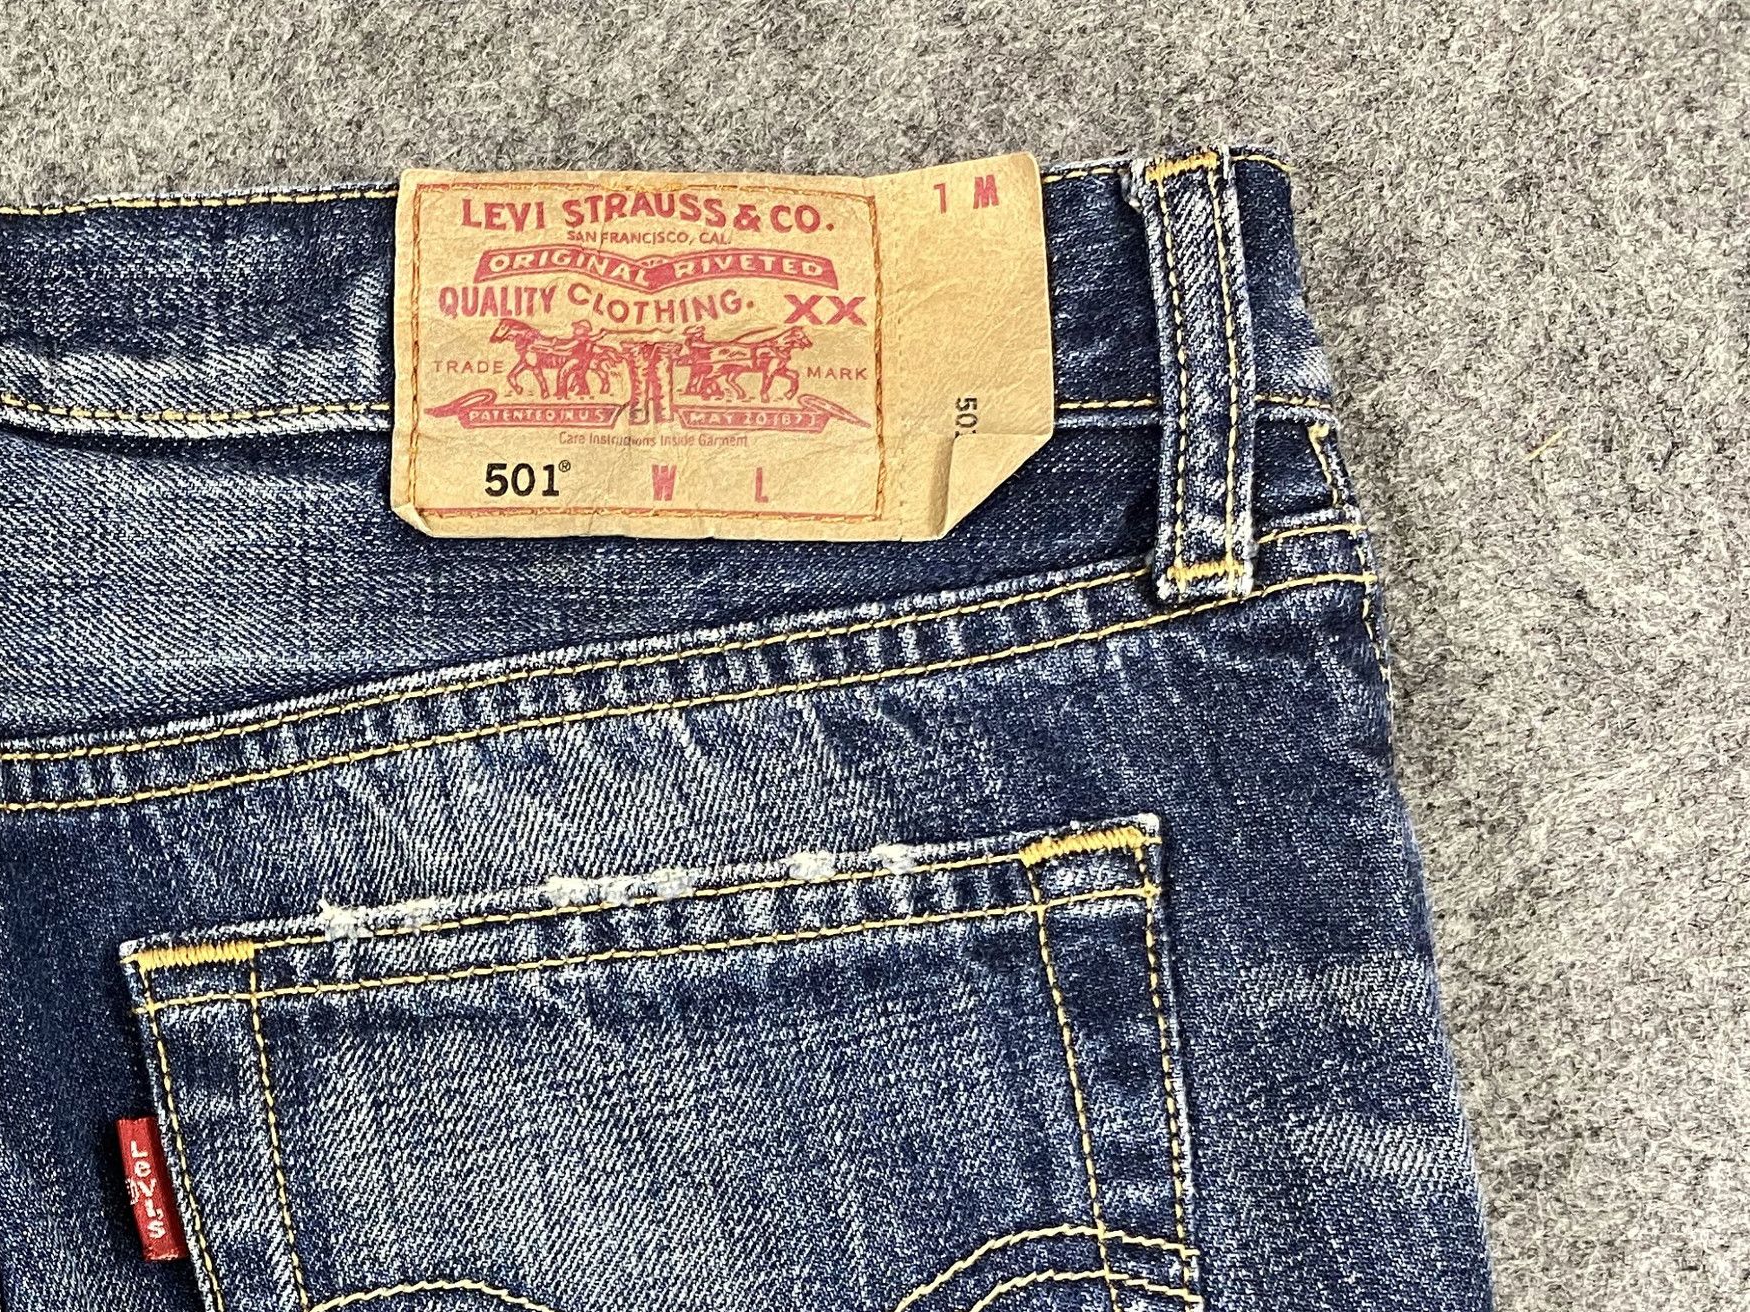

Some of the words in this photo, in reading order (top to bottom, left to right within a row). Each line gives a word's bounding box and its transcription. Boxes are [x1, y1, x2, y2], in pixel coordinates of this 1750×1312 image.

[461, 198, 546, 232] LEVI
[562, 191, 727, 229] STRAUSS
[733, 203, 761, 233] &
[769, 204, 835, 234] CO.
[567, 230, 597, 243] SAN
[600, 230, 695, 246] FRANCISCO,
[699, 231, 732, 246] CAL.
[488, 249, 651, 287] ORIGINAL
[672, 254, 824, 279] RIVETED
[438, 285, 558, 319] QUALITY
[567, 282, 755, 325] CLOTHING.
[783, 294, 868, 326] XX
[433, 359, 505, 375] TRADE
[806, 366, 869, 381] MARK
[468, 407, 557, 422] PATENTED
[689, 411, 735, 425] MAY
[558, 431, 586, 445] Care
[660, 434, 695, 447] Inside
[698, 433, 748, 447] Garment
[651, 464, 678, 502] W
[754, 466, 770, 503] L
